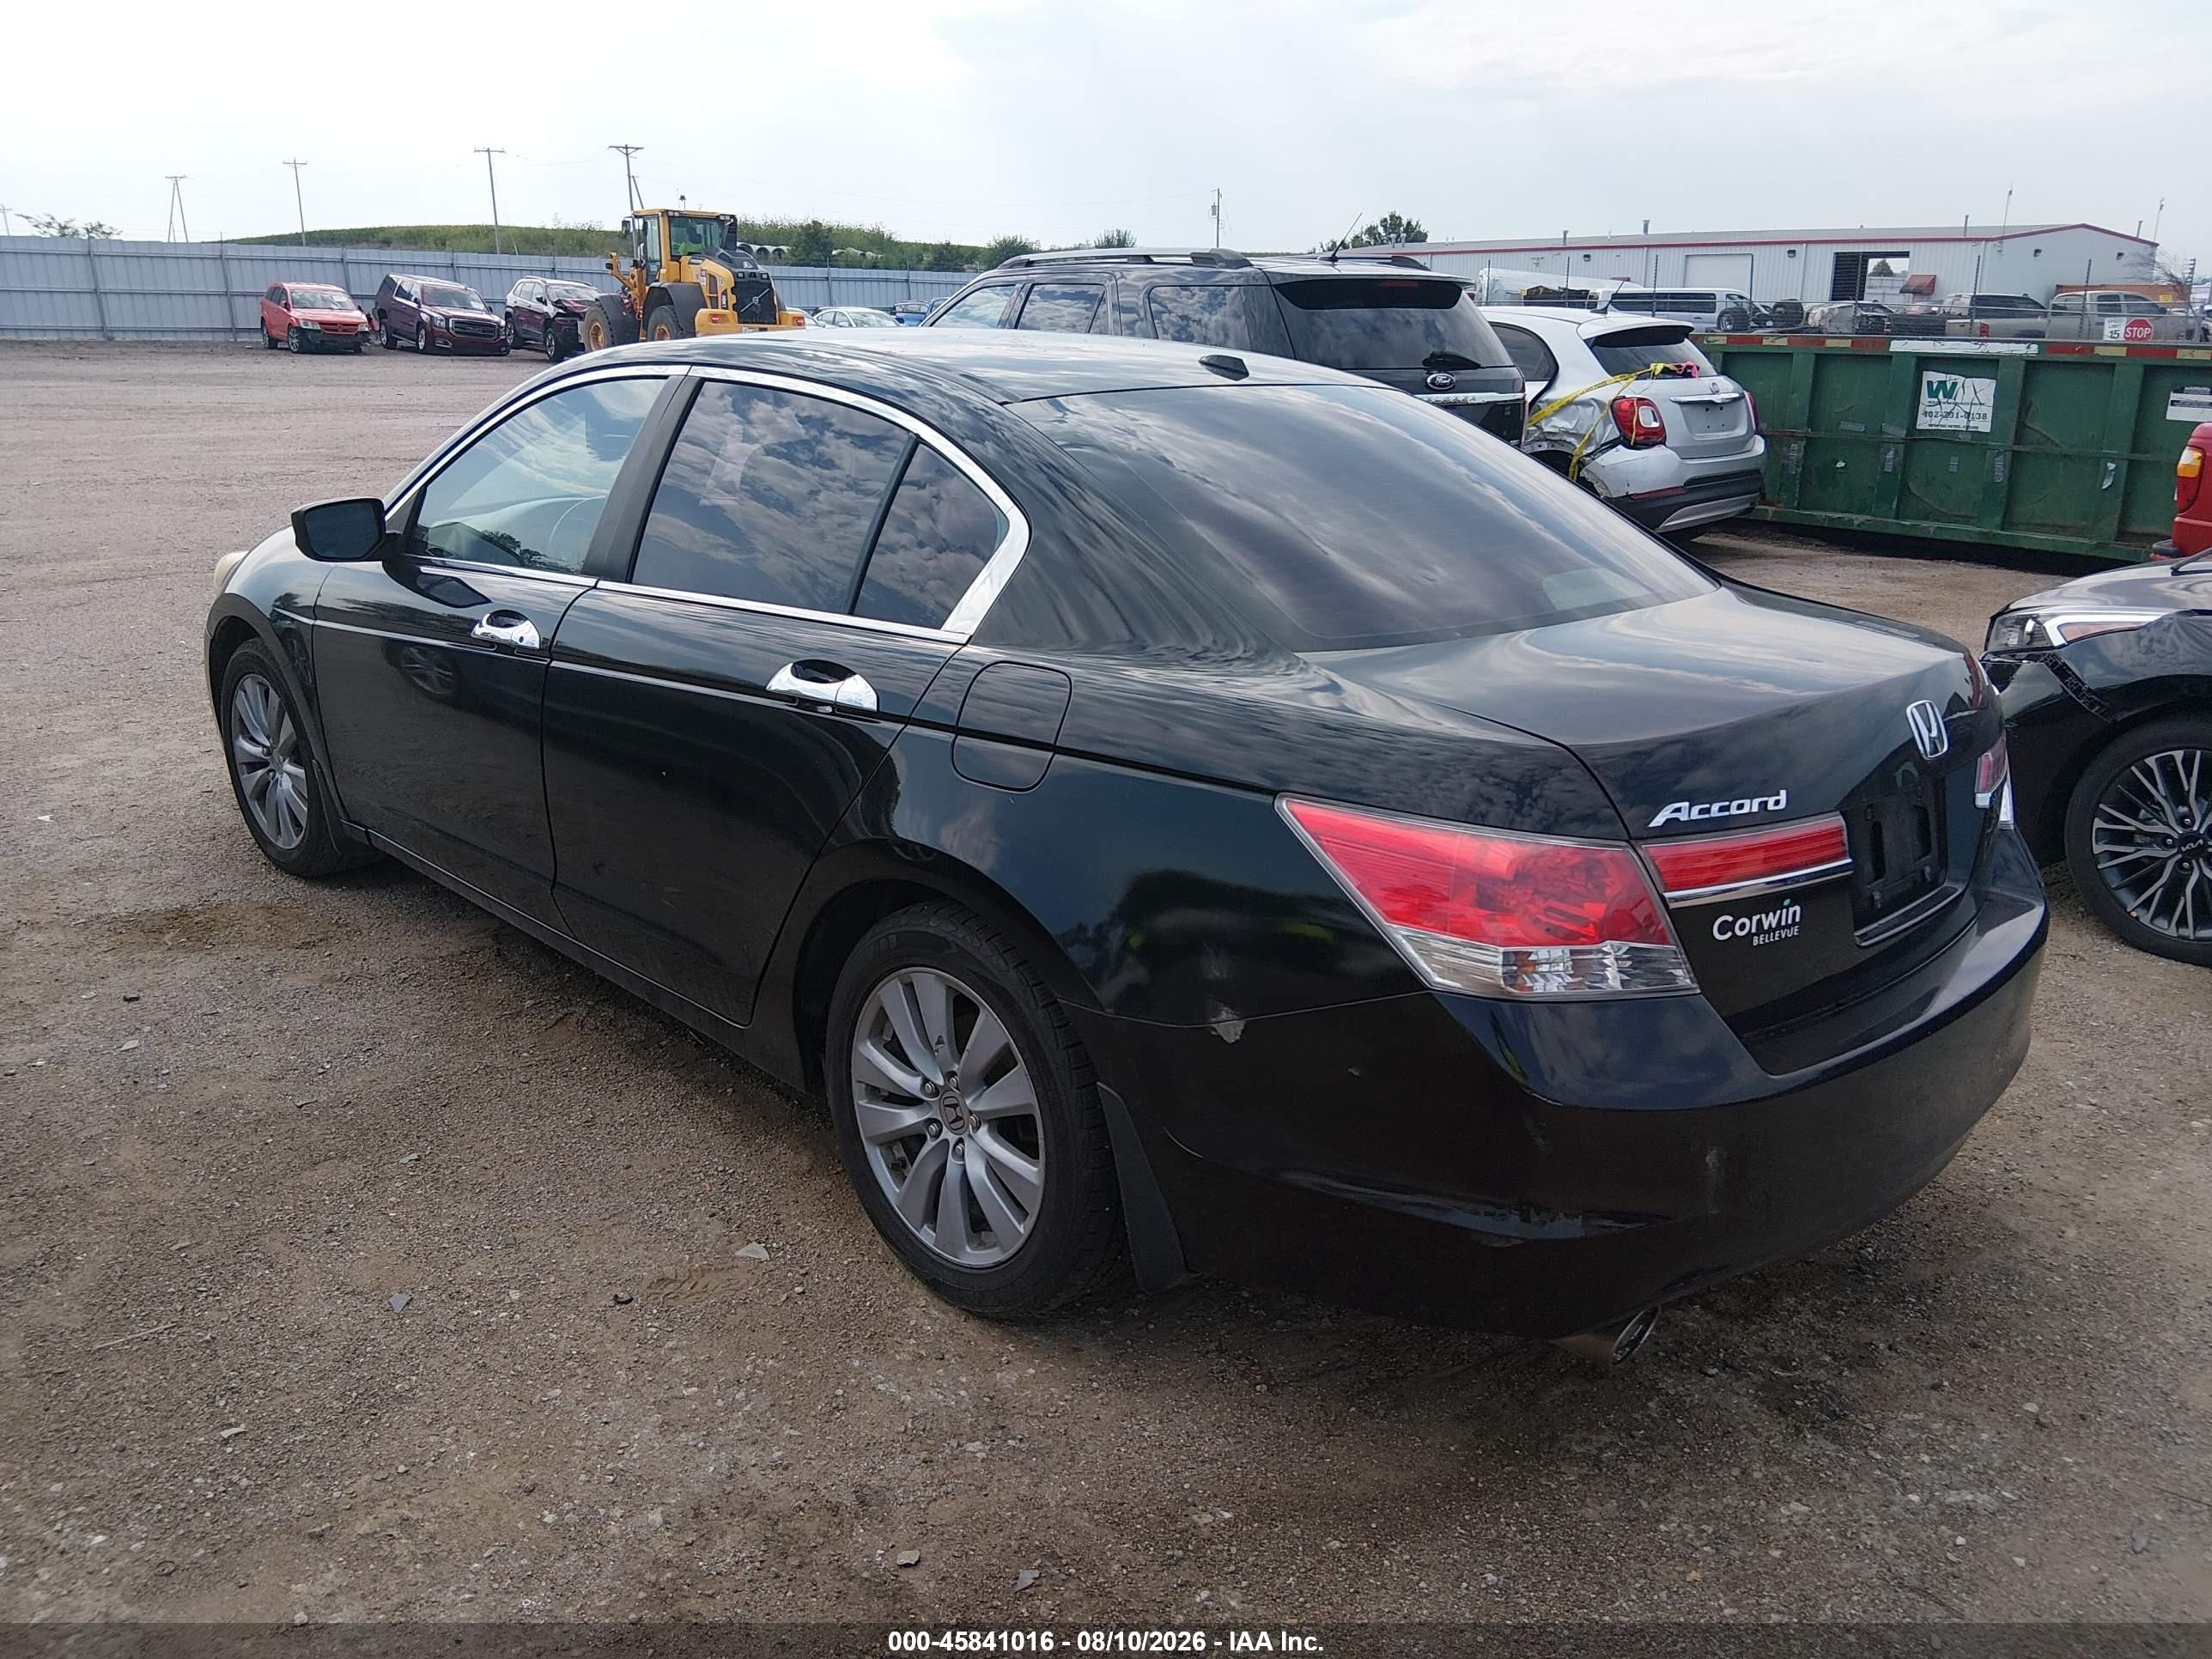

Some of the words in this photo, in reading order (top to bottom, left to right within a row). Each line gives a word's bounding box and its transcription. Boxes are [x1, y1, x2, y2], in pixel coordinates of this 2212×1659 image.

[2108, 329, 2120, 339] 15
[2124, 326, 2151, 338] STOP
[1435, 376, 1451, 386] Ford
[1648, 789, 1787, 828] Accord
[1712, 898, 1802, 941] Corwin
[1753, 925, 1800, 946] BELLEVUE
